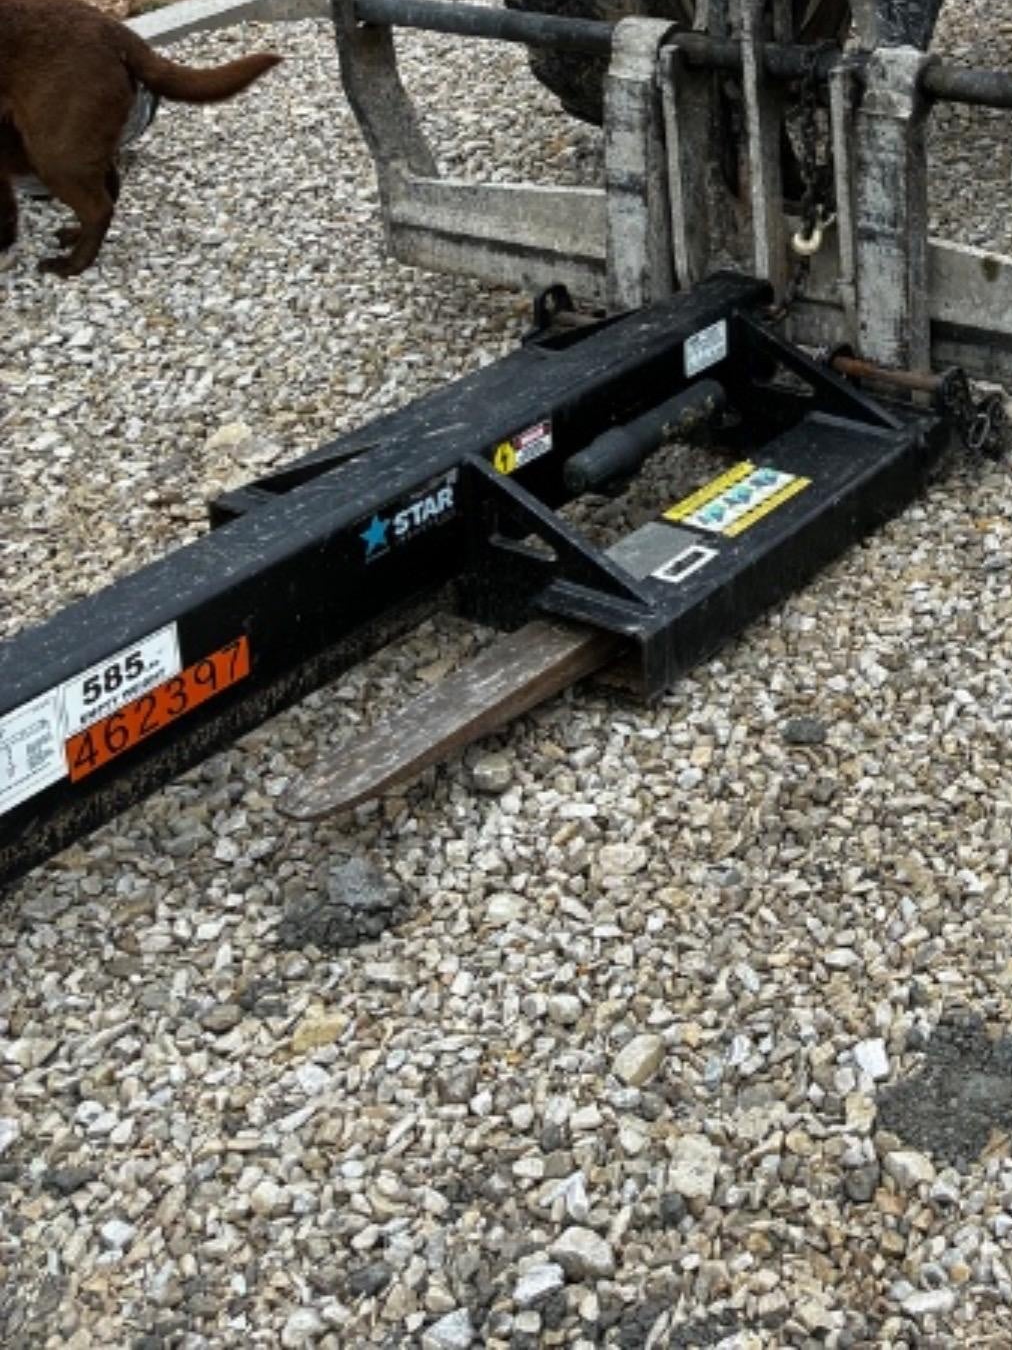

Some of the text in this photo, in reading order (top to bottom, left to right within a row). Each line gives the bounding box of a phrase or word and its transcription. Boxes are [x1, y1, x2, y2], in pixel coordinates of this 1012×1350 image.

[393, 487, 454, 535] STAR
[73, 639, 242, 769] 462397
[83, 651, 144, 705] 585
